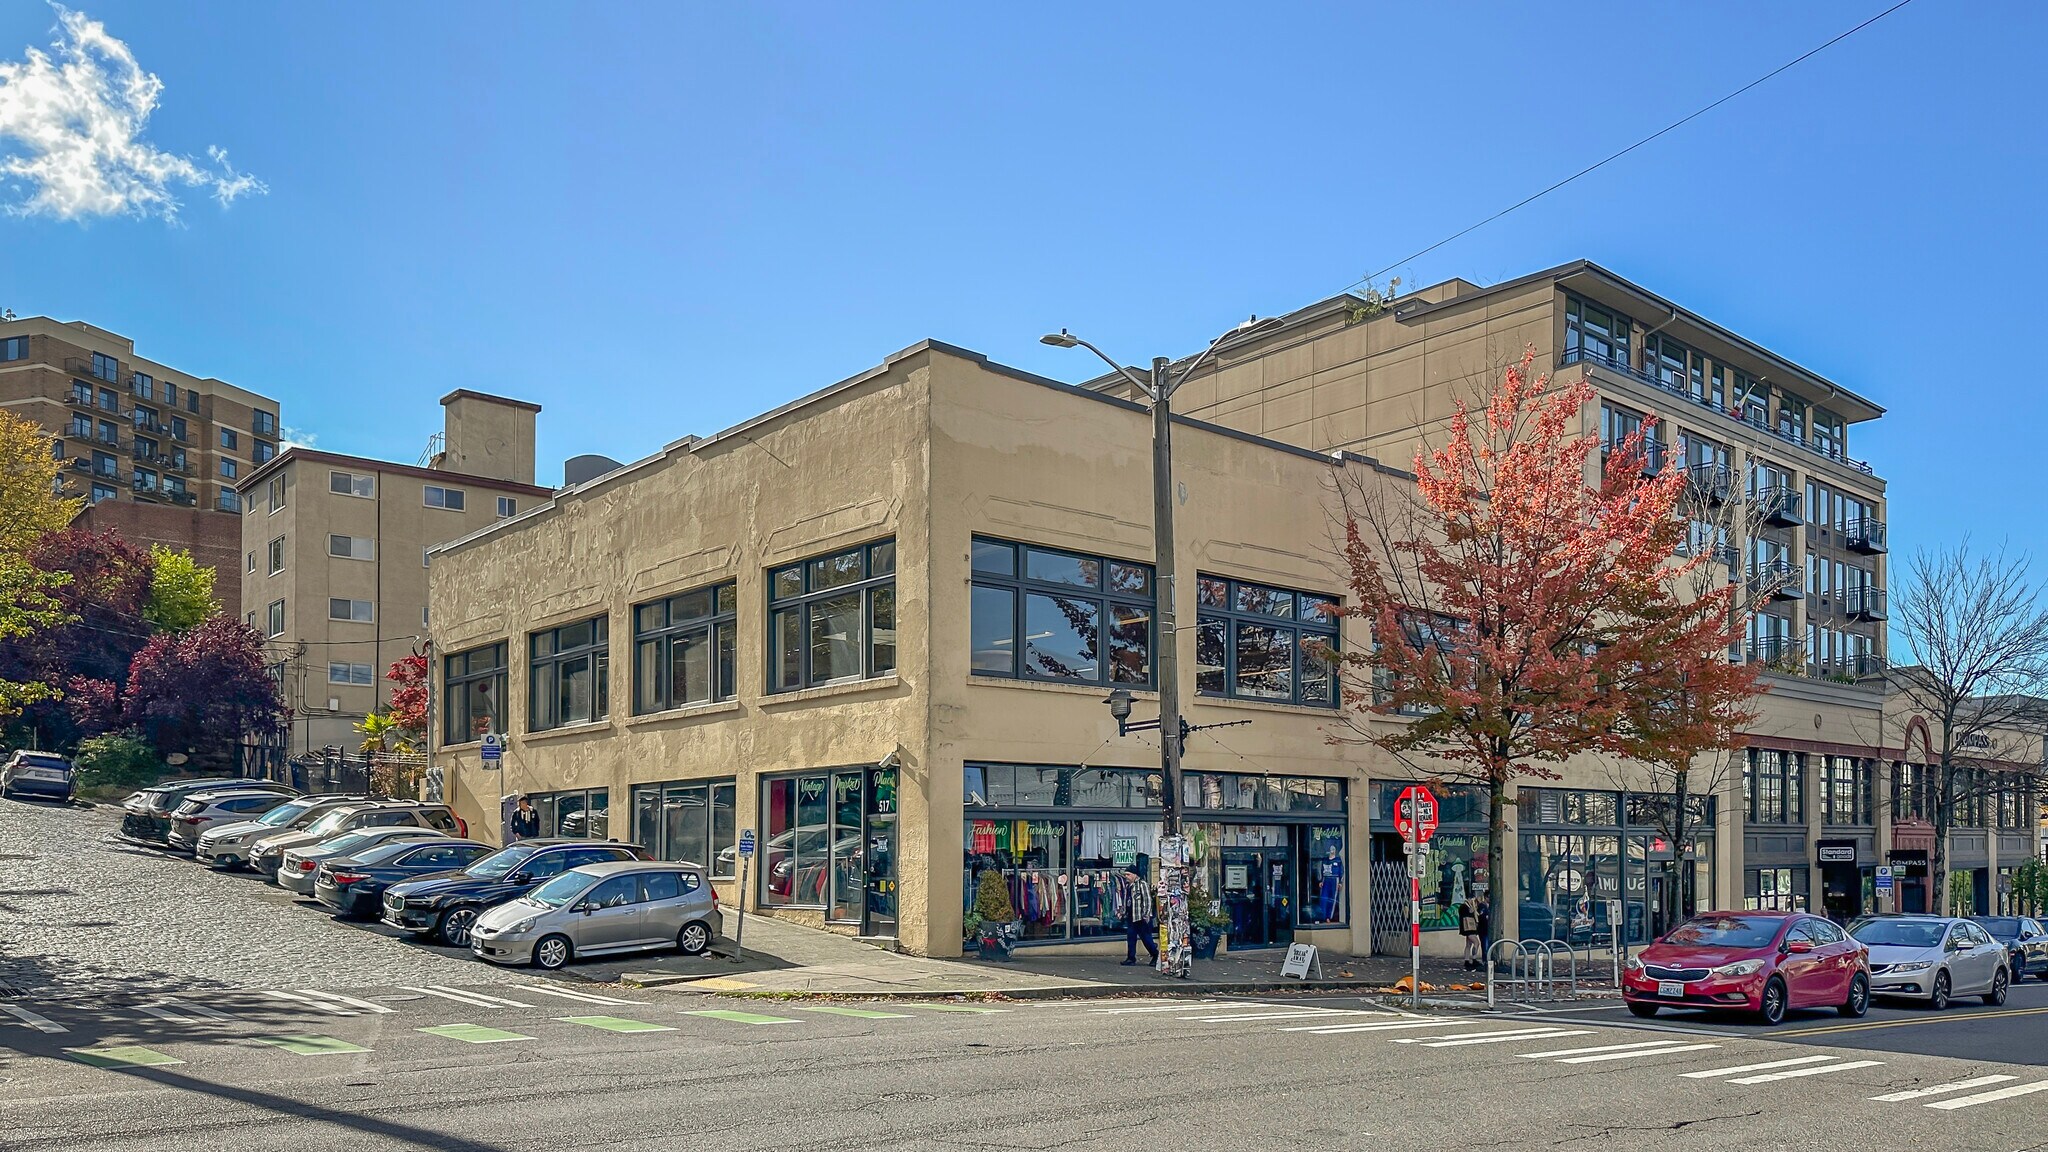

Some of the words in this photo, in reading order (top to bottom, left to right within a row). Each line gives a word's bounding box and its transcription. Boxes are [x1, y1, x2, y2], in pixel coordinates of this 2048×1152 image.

[800, 778, 825, 797] Vintage
[878, 800, 890, 812] 517
[968, 823, 1008, 842] Fashion
[1024, 823, 1065, 837] Furniture
[1112, 840, 1136, 851] BREAK
[1116, 852, 1134, 863] AWAY
